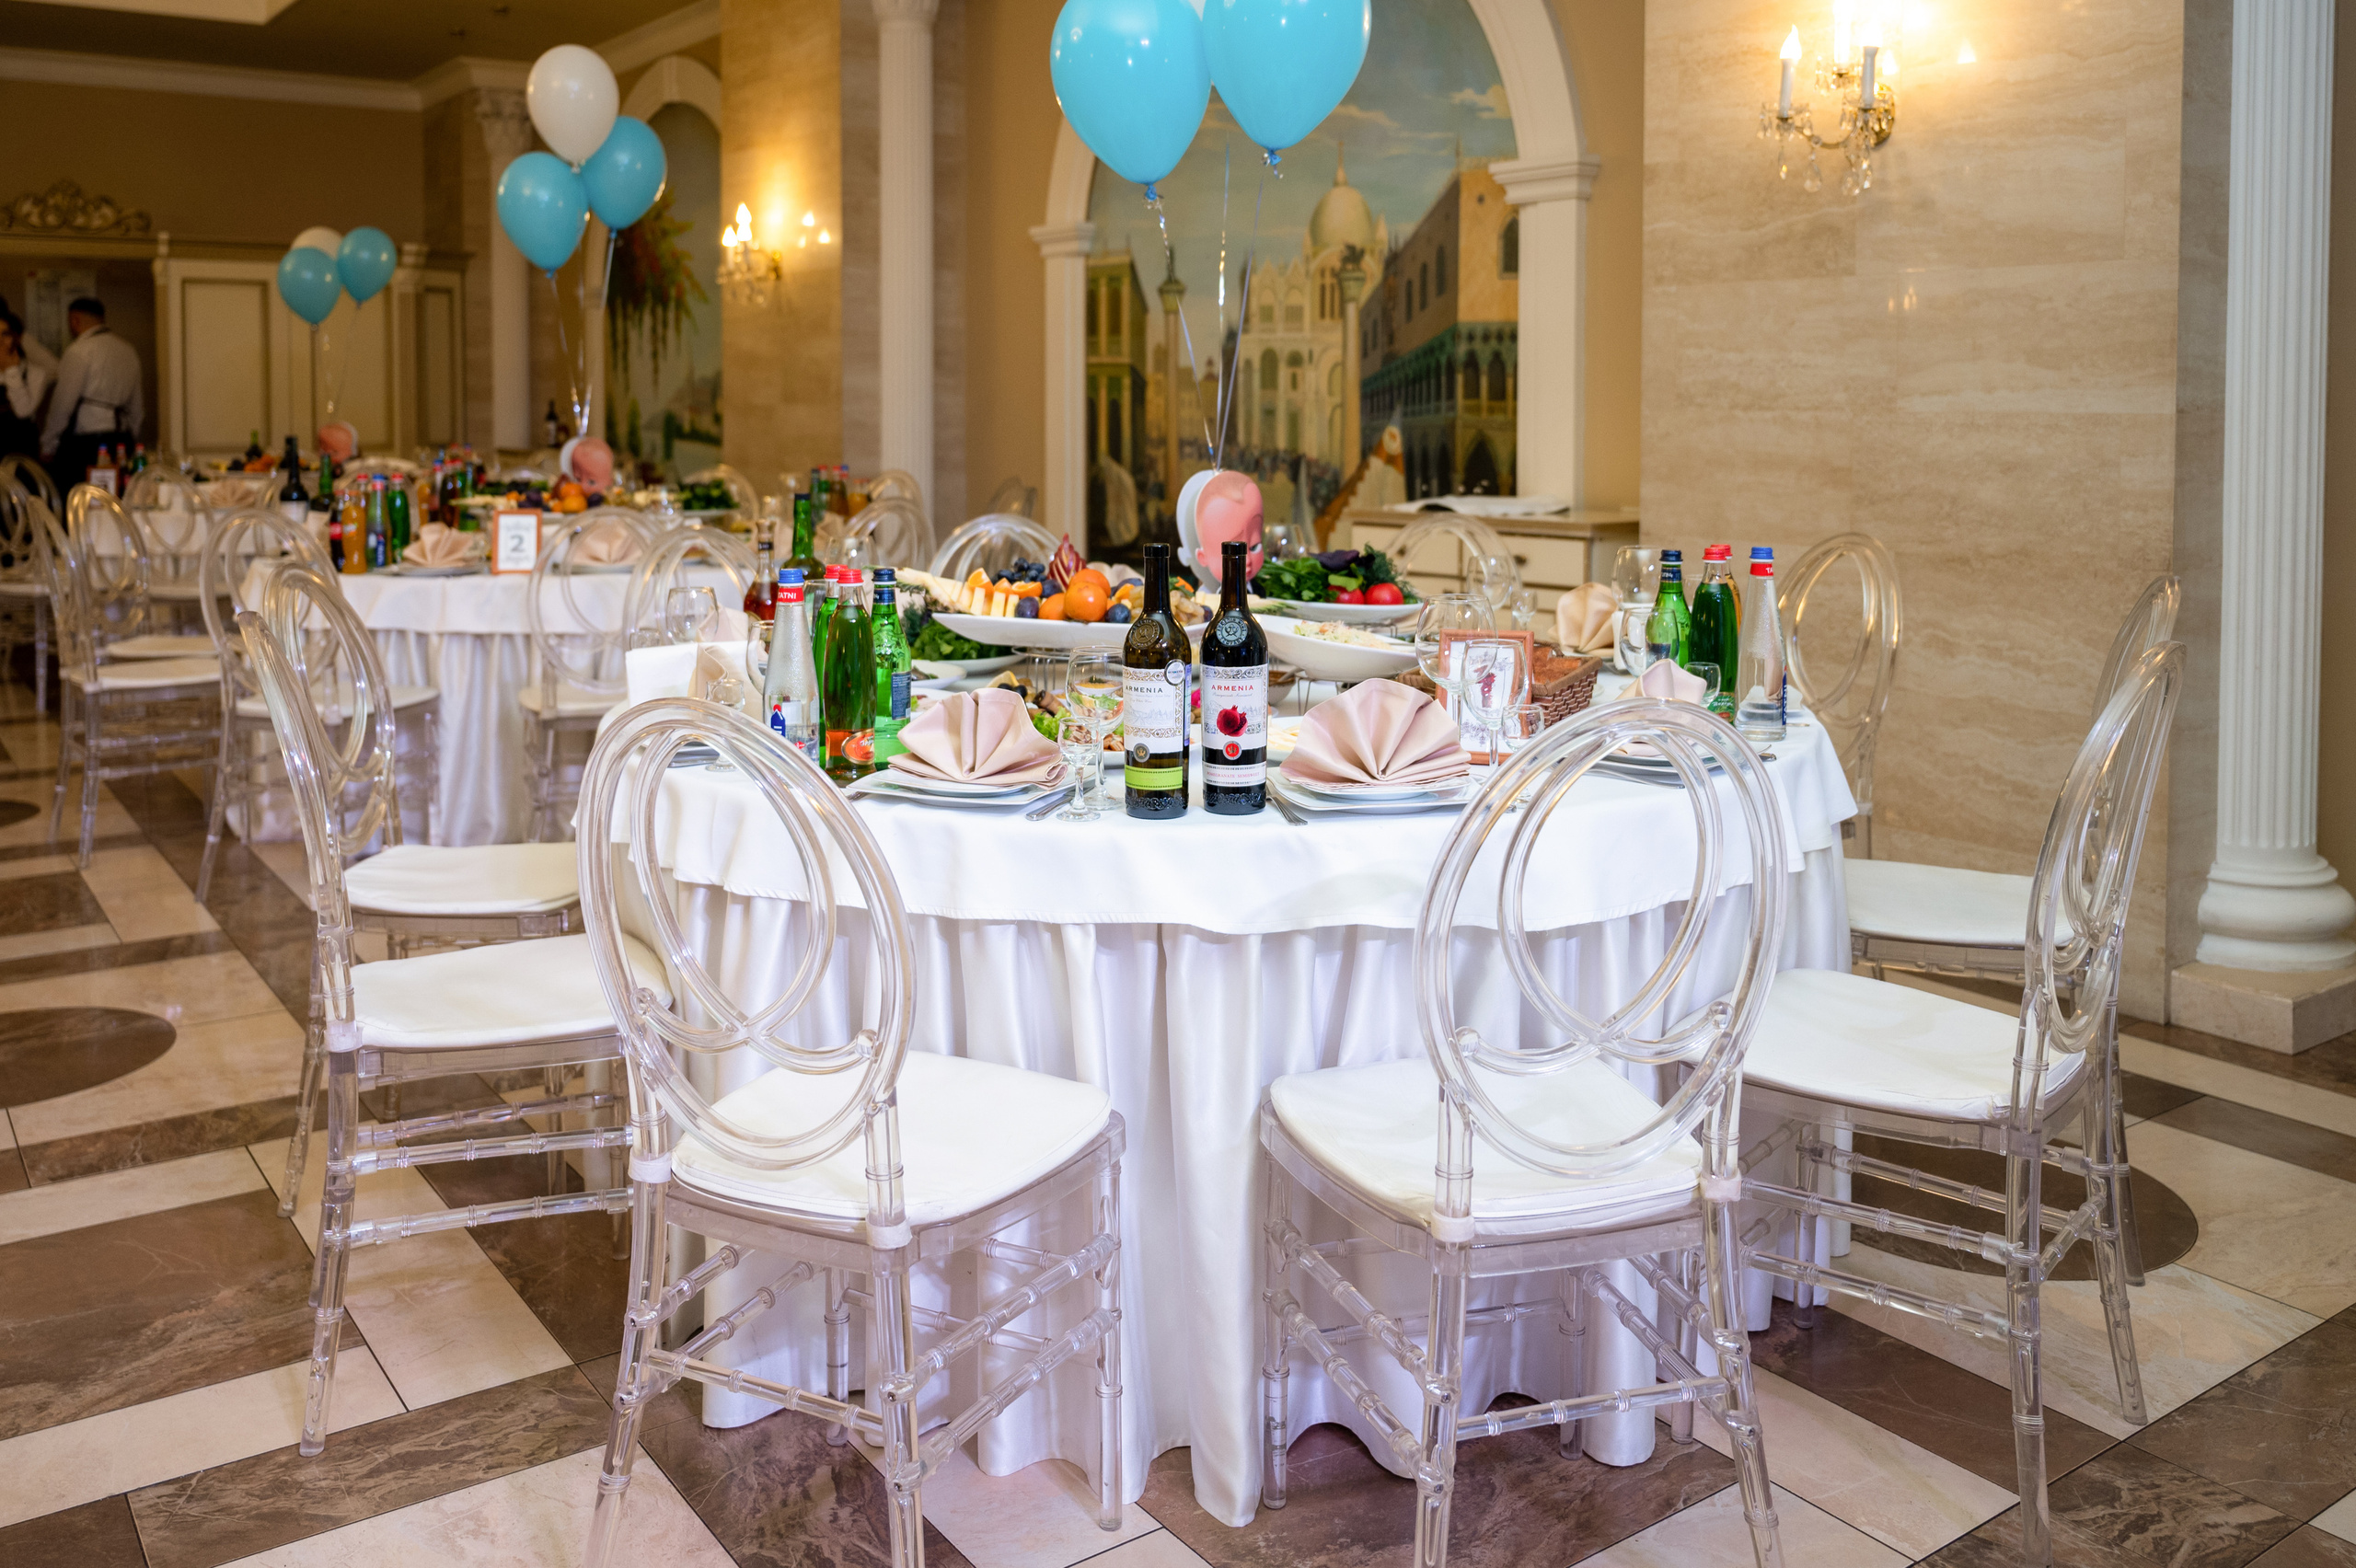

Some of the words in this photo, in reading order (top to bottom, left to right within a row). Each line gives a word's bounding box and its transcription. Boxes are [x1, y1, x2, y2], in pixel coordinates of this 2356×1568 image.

[510, 534, 525, 553] 2
[1125, 685, 1163, 694] ARMENIA
[1211, 684, 1254, 692] ARMENIA
